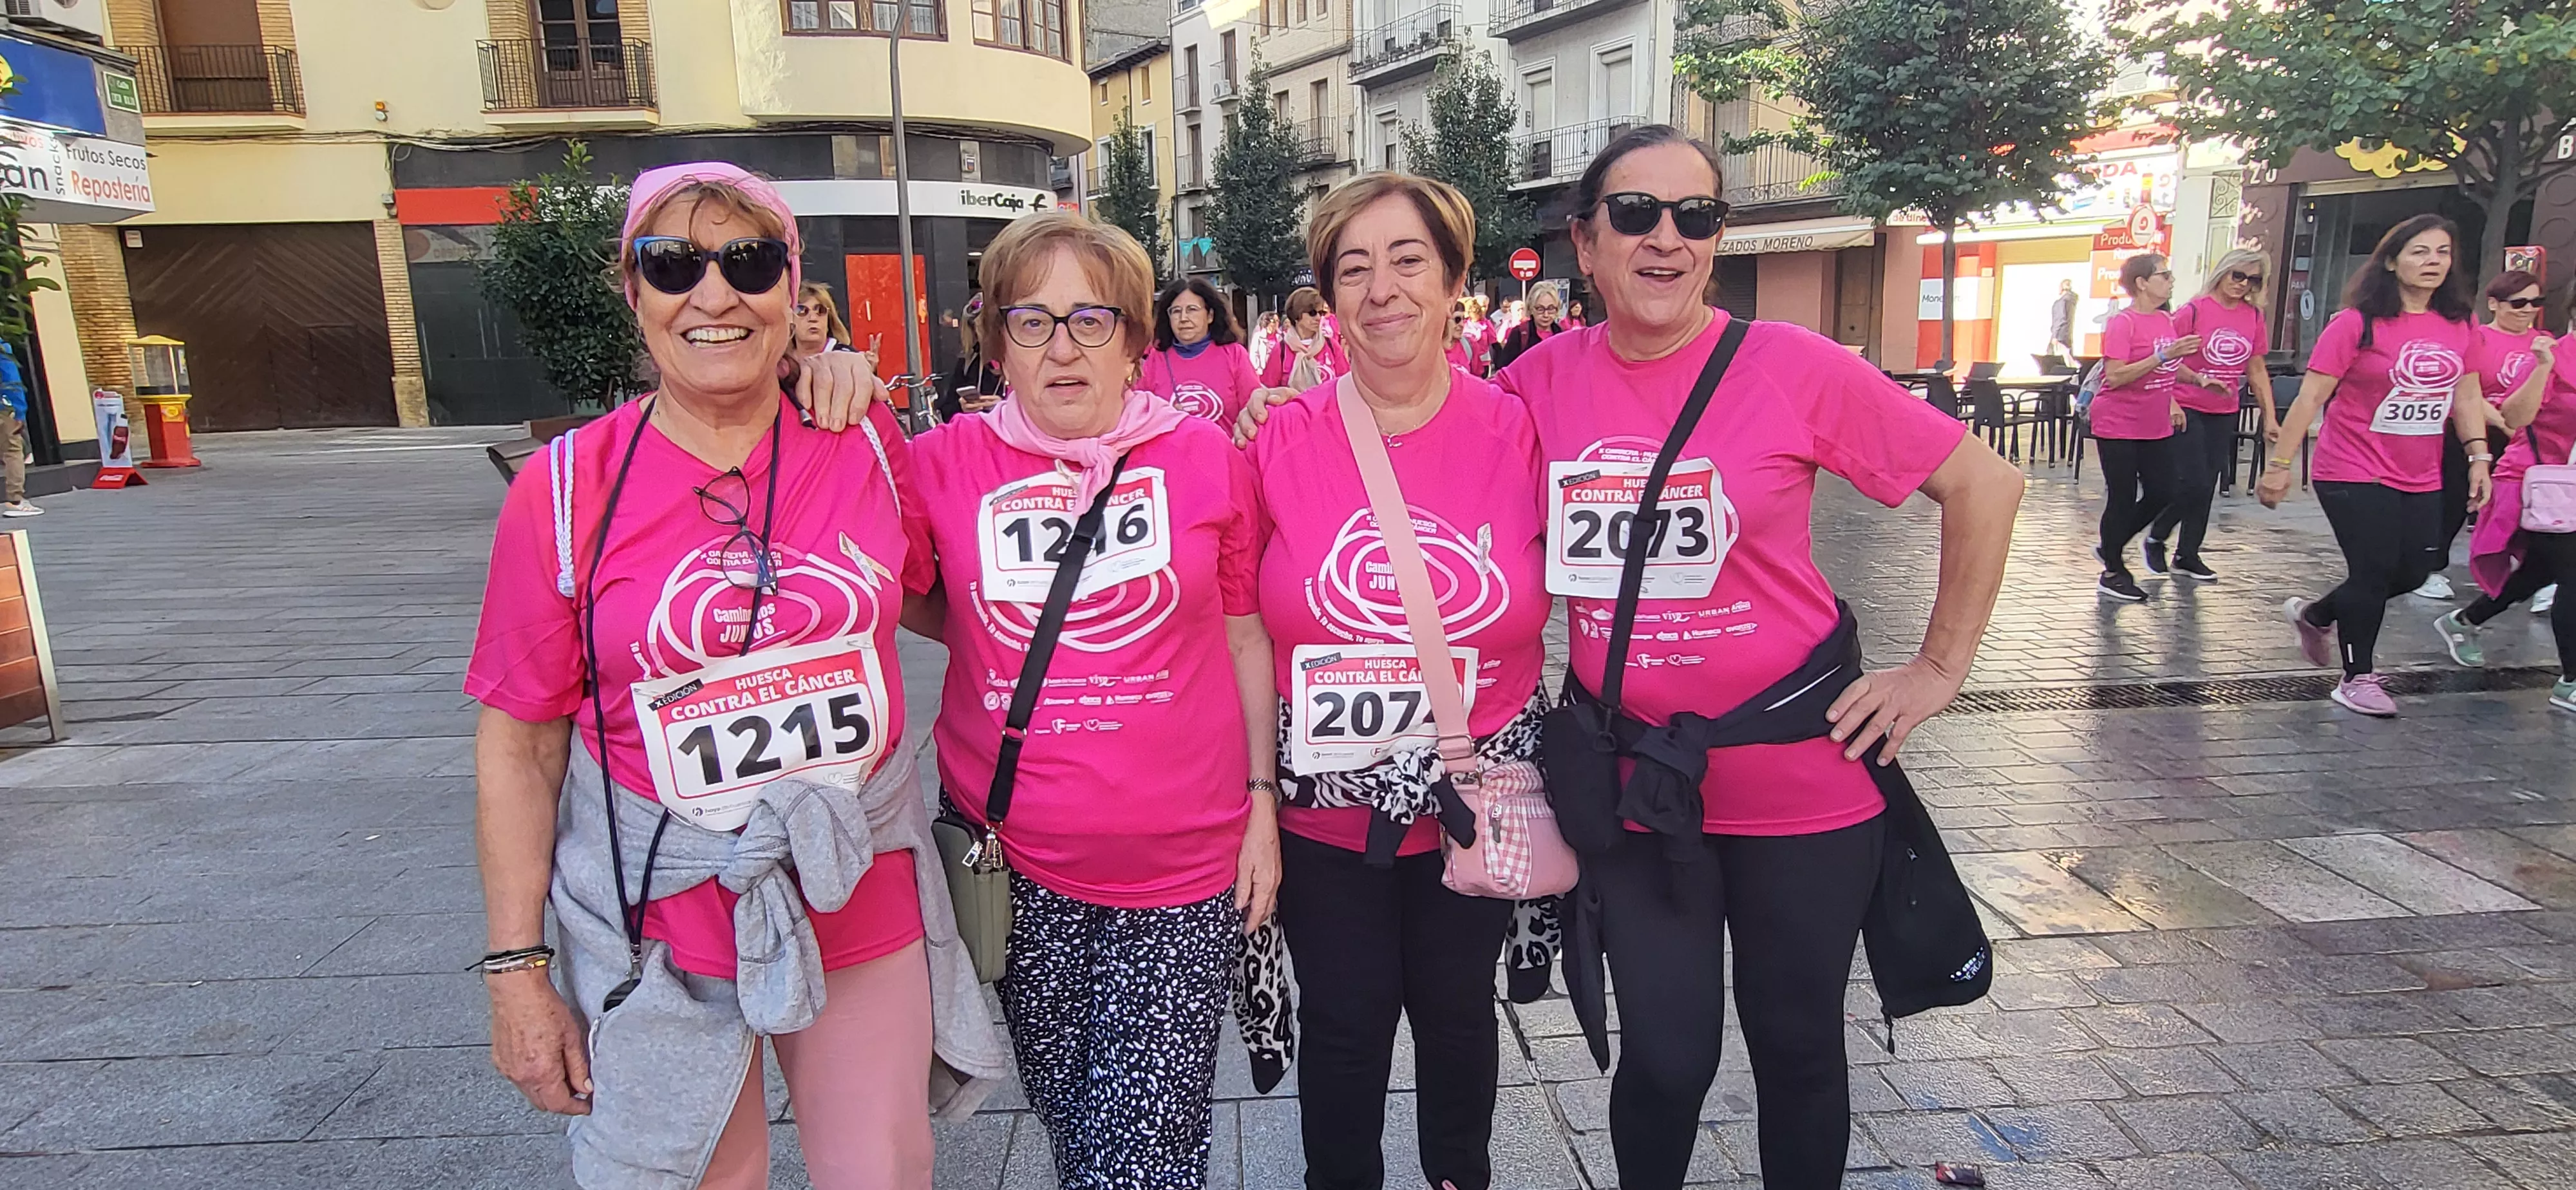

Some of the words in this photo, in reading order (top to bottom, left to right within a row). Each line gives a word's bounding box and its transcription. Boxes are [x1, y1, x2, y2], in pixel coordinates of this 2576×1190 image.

[65, 143, 105, 164] Frutos
[108, 150, 146, 171] Secos
[71, 170, 151, 203] Repostería
[960, 190, 1023, 212] iberCaja
[1906, 212, 1927, 222] dine
[1721, 240, 1757, 252] ZADOS
[1763, 236, 1814, 250] MORENO
[2384, 403, 2443, 420] 3056
[1571, 489, 1635, 502] CONTRA
[1658, 484, 1703, 500] ÁNCER
[1623, 478, 1648, 489] HUE
[1001, 497, 1065, 511] CONTRA
[1066, 499, 1076, 511] E
[1106, 488, 1146, 506] NCER
[1567, 506, 1709, 559] 2073
[1369, 574, 1396, 590] JUN
[720, 618, 775, 643] JUNOS
[1365, 659, 1407, 669] HUESCA
[735, 668, 793, 691] HUESCA
[1314, 670, 1377, 684] CONTRA
[1379, 670, 1396, 683] EL
[662, 683, 697, 705] EDICIÓN
[670, 690, 756, 721] CONTRA
[758, 686, 782, 703] EL
[784, 668, 858, 695] CÁNCER
[1311, 690, 1436, 738] 207
[677, 692, 870, 786] 1215
